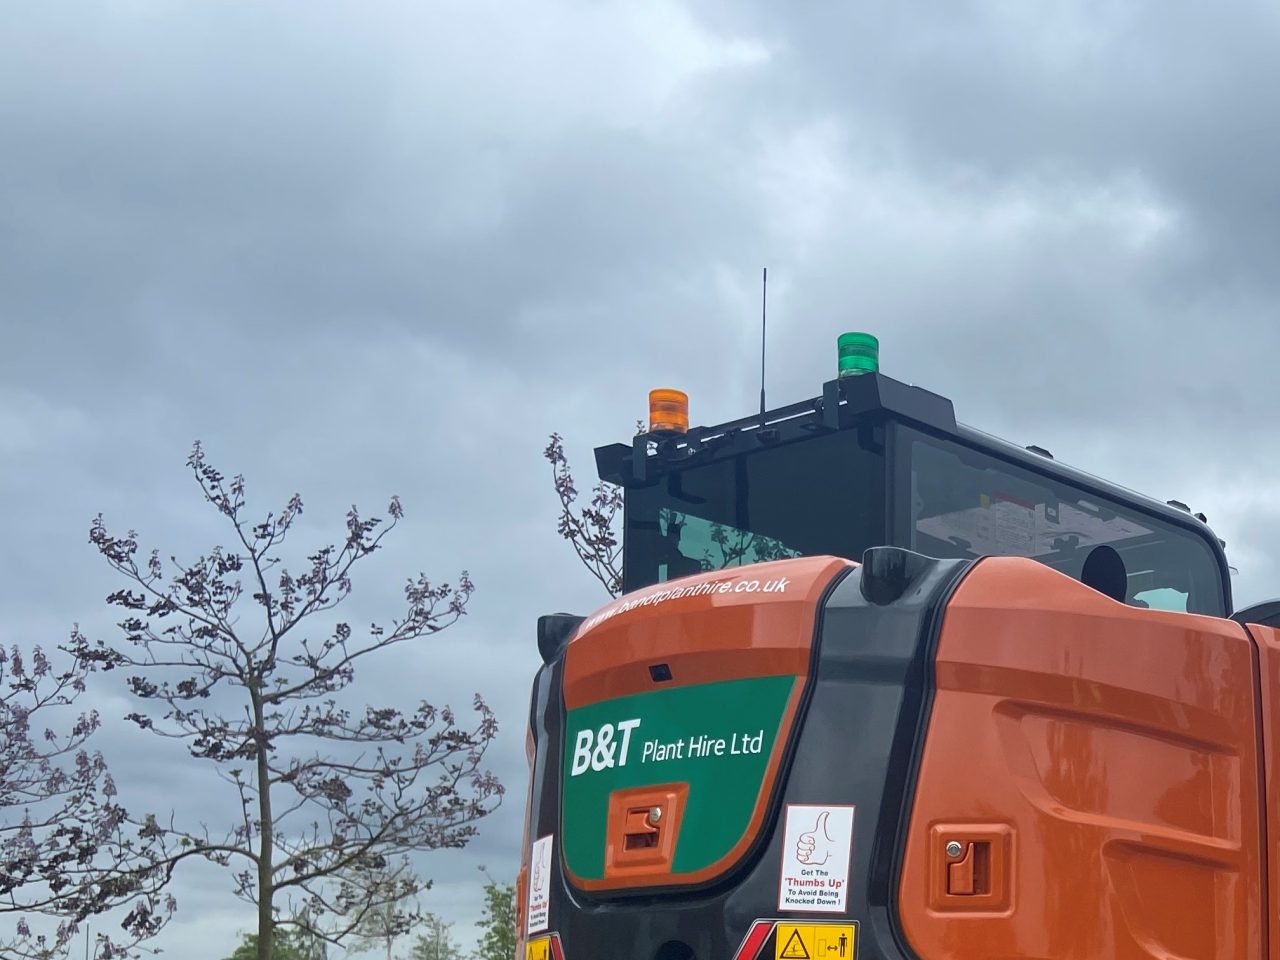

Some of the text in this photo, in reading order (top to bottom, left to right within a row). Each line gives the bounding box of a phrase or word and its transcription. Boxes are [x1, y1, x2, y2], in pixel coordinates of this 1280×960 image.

[571, 718, 764, 777] B&T Plant Hire Ltd
[819, 890, 839, 898] Being
[785, 897, 815, 905] Knocked
